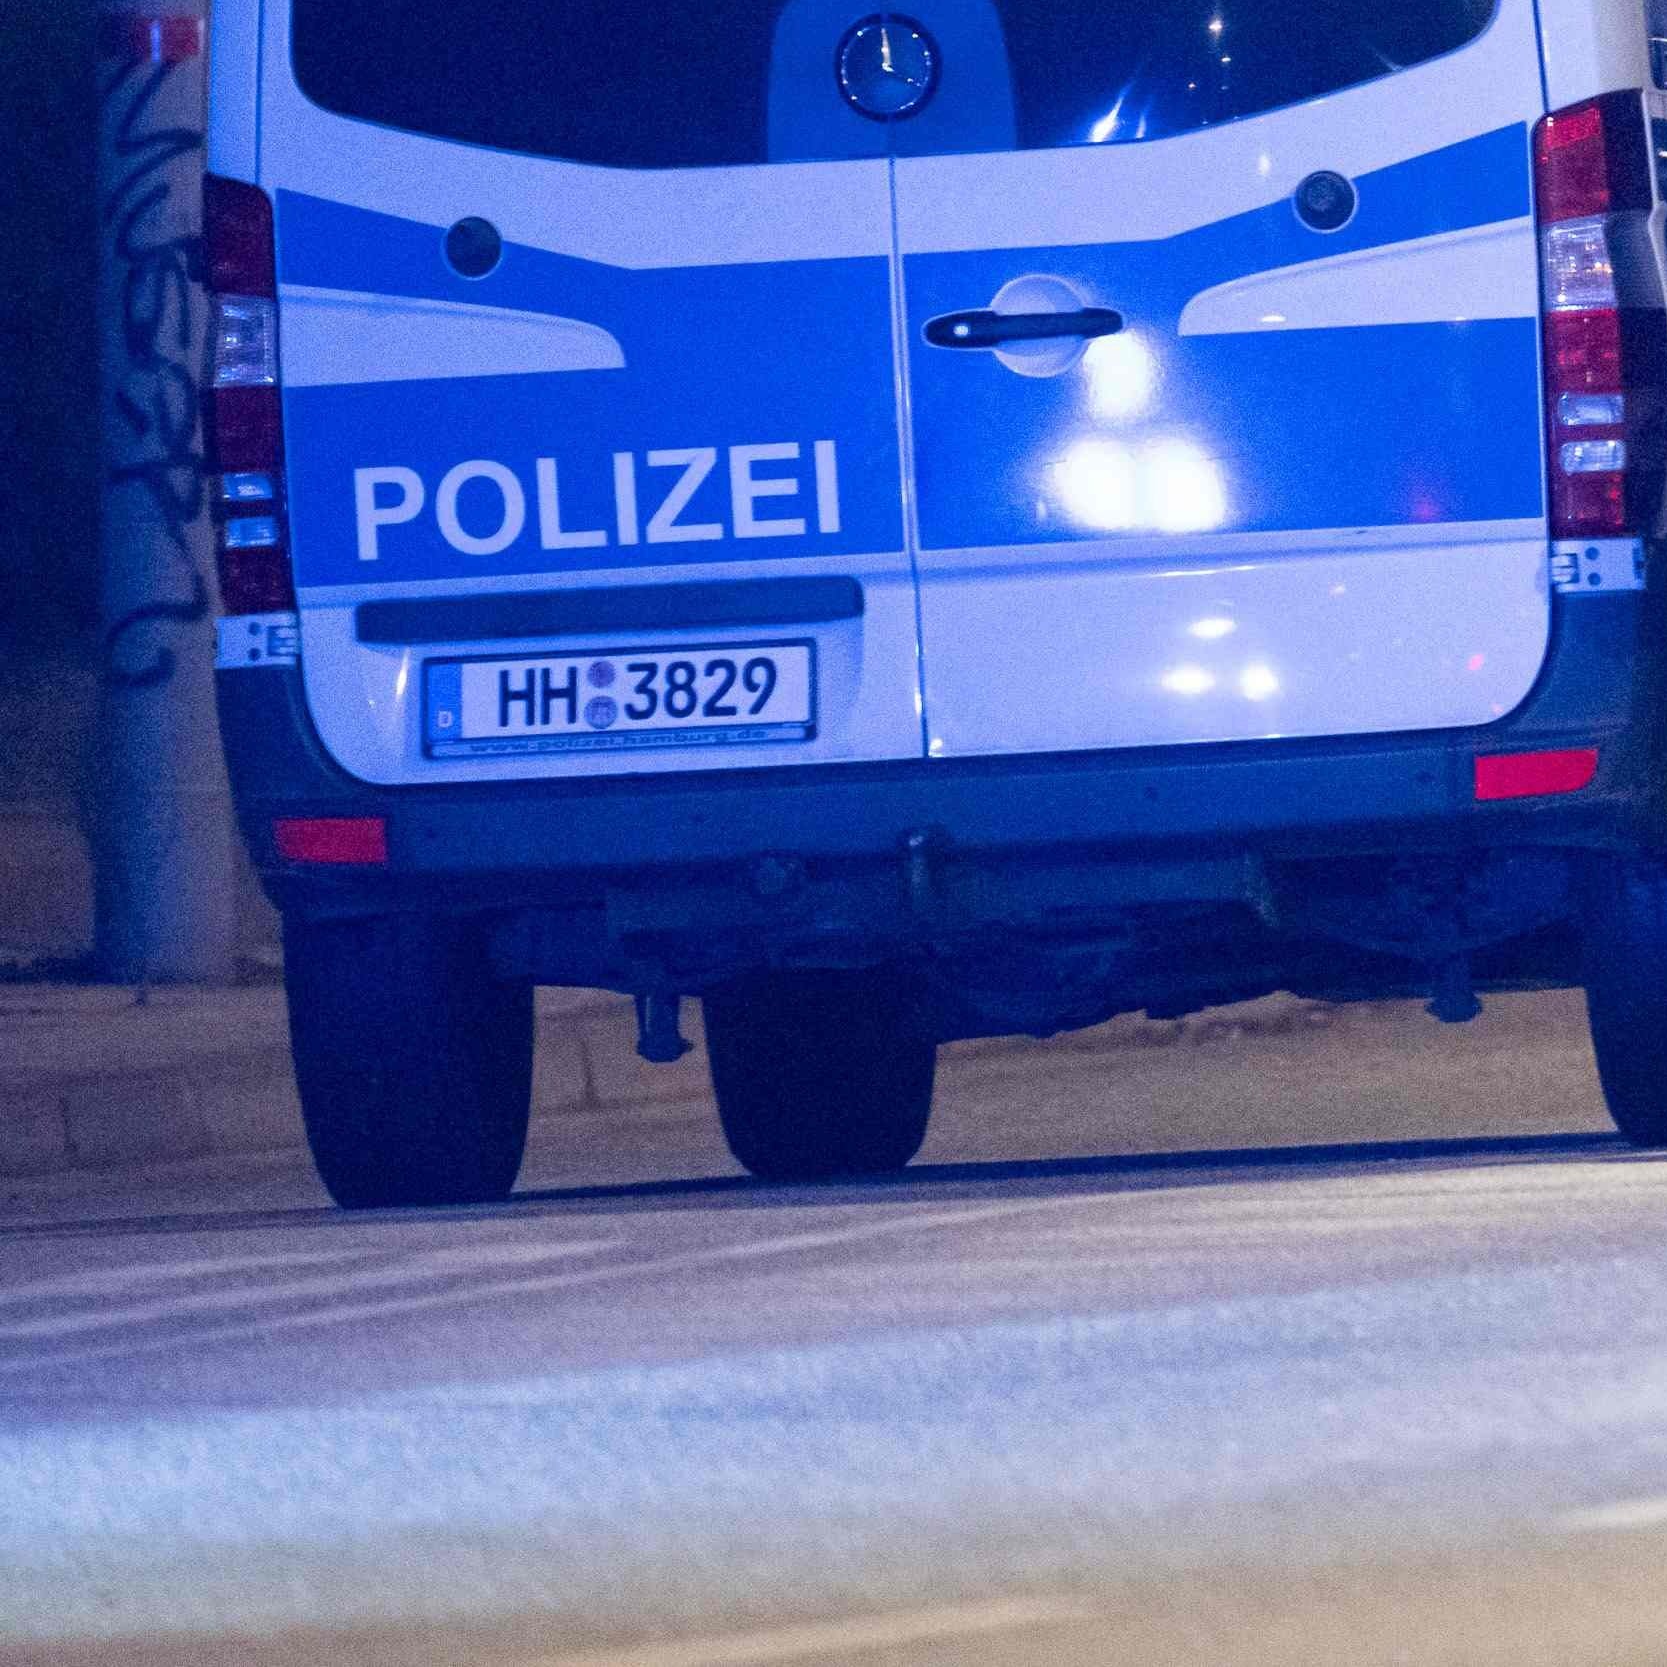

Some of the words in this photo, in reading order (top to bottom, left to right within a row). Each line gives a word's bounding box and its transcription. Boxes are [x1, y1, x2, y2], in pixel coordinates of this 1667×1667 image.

[354, 440, 841, 561] POLIZEI
[500, 666, 577, 728] HH
[625, 657, 777, 721] 3829
